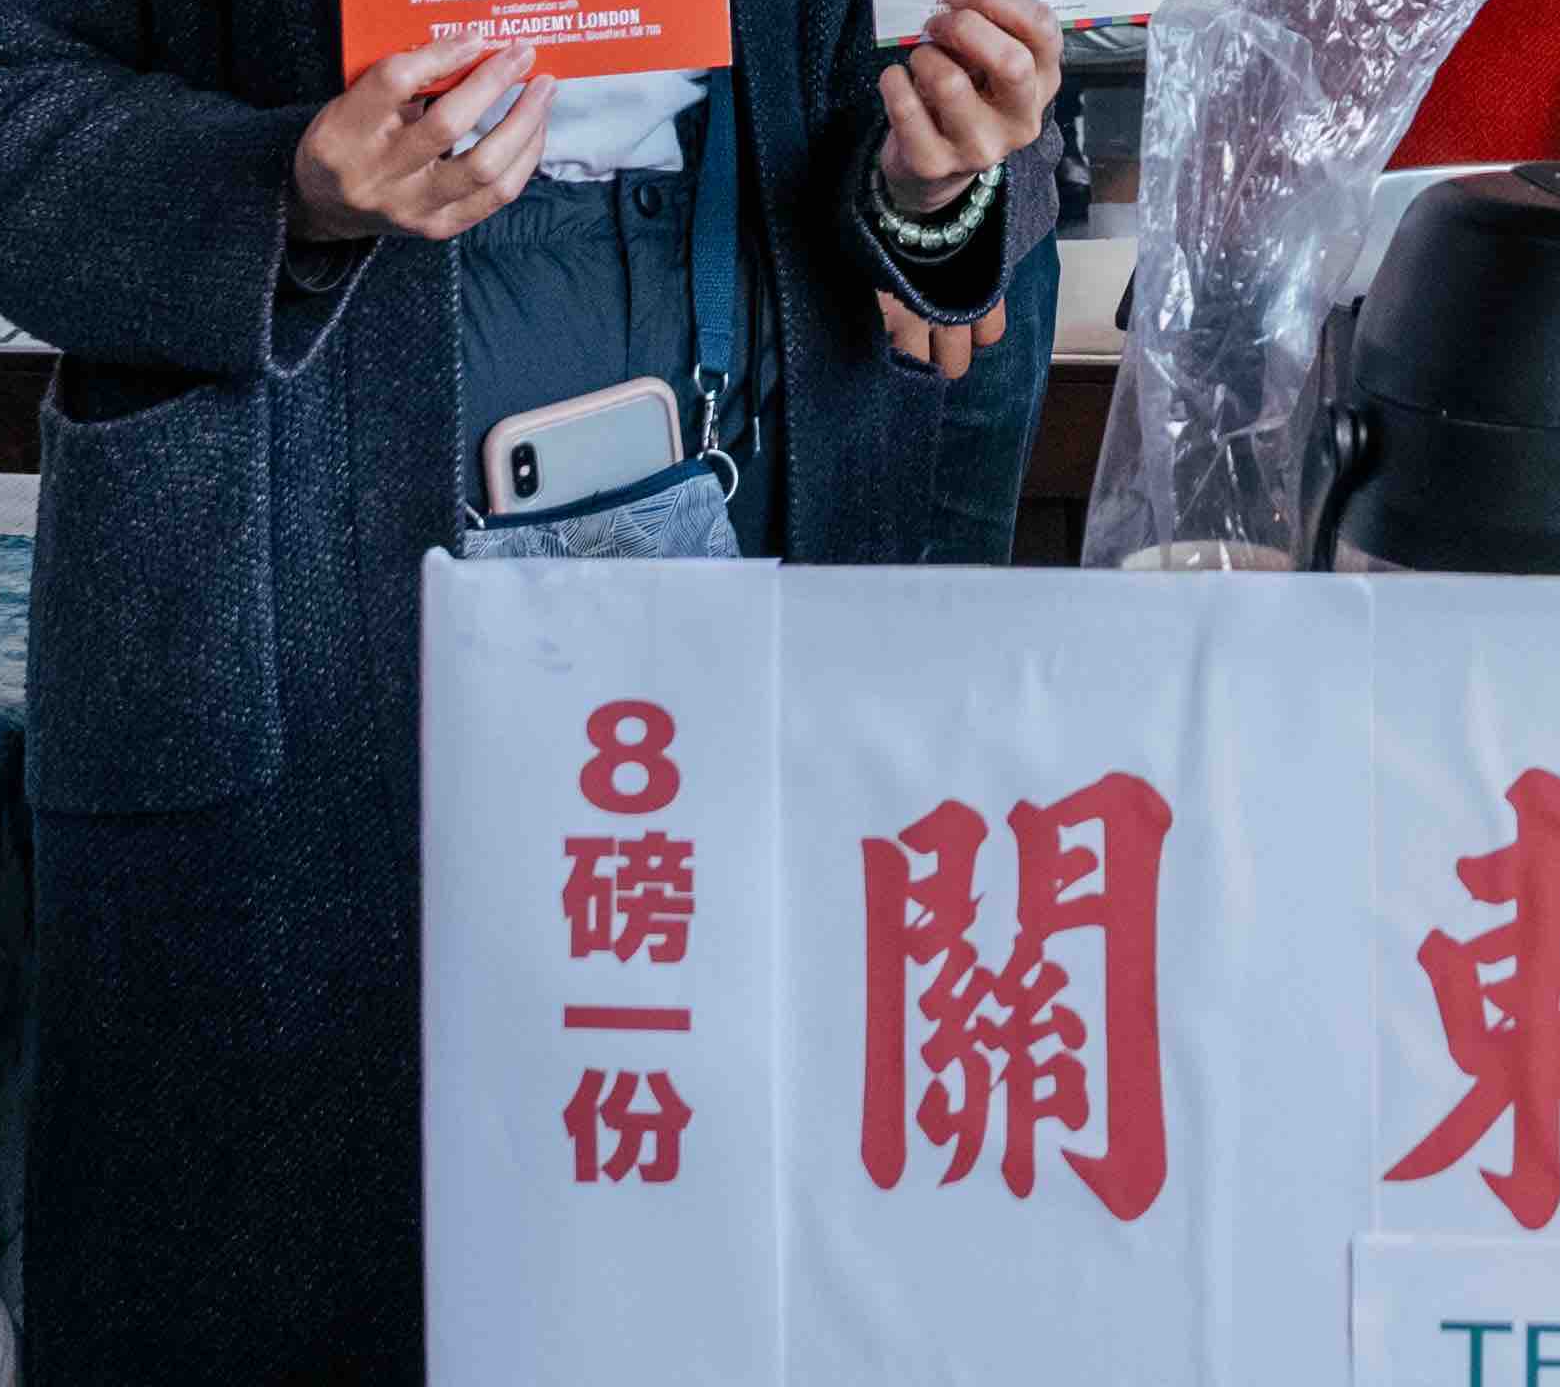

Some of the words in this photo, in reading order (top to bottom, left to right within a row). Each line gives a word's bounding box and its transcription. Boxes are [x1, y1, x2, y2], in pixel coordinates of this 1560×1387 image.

[500, 14, 574, 36] ACADEMY
[578, 9, 640, 30] LONDON
[561, 700, 696, 1184] 8磅一份
